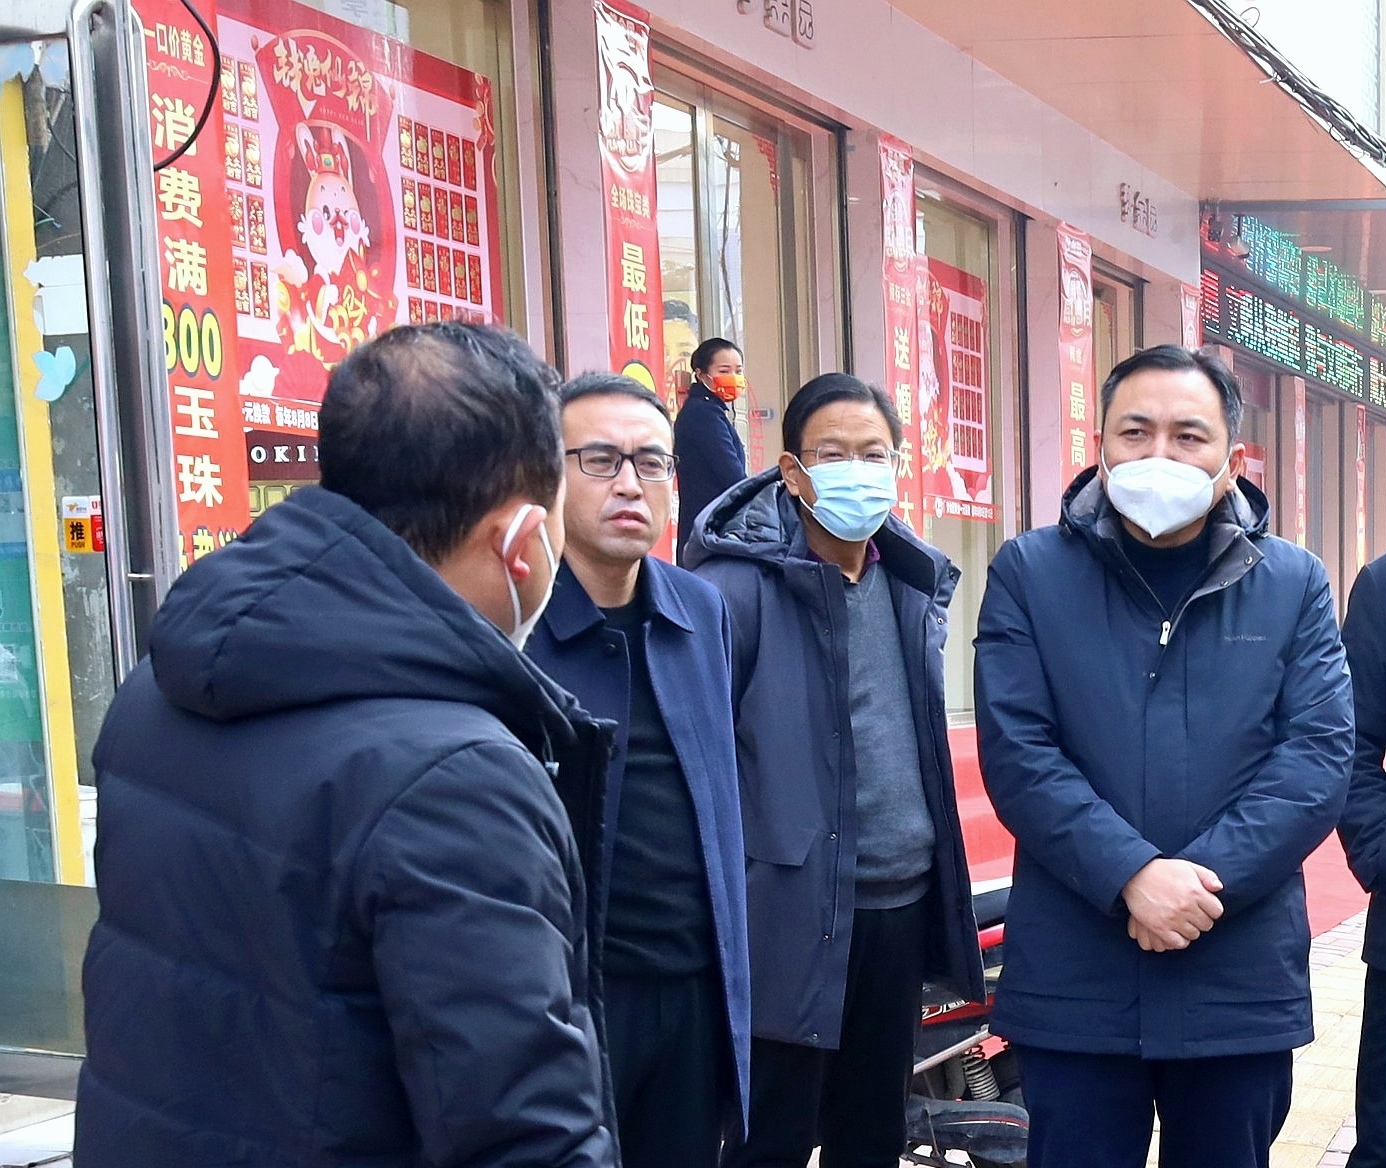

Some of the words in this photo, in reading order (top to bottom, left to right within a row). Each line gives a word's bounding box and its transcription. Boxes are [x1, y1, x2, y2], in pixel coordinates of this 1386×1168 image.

[143, 22, 206, 67] 一口价黄金
[1069, 381, 1087, 479] 最高
[250, 446, 319, 463] OKI
[70, 521, 85, 541] 推
